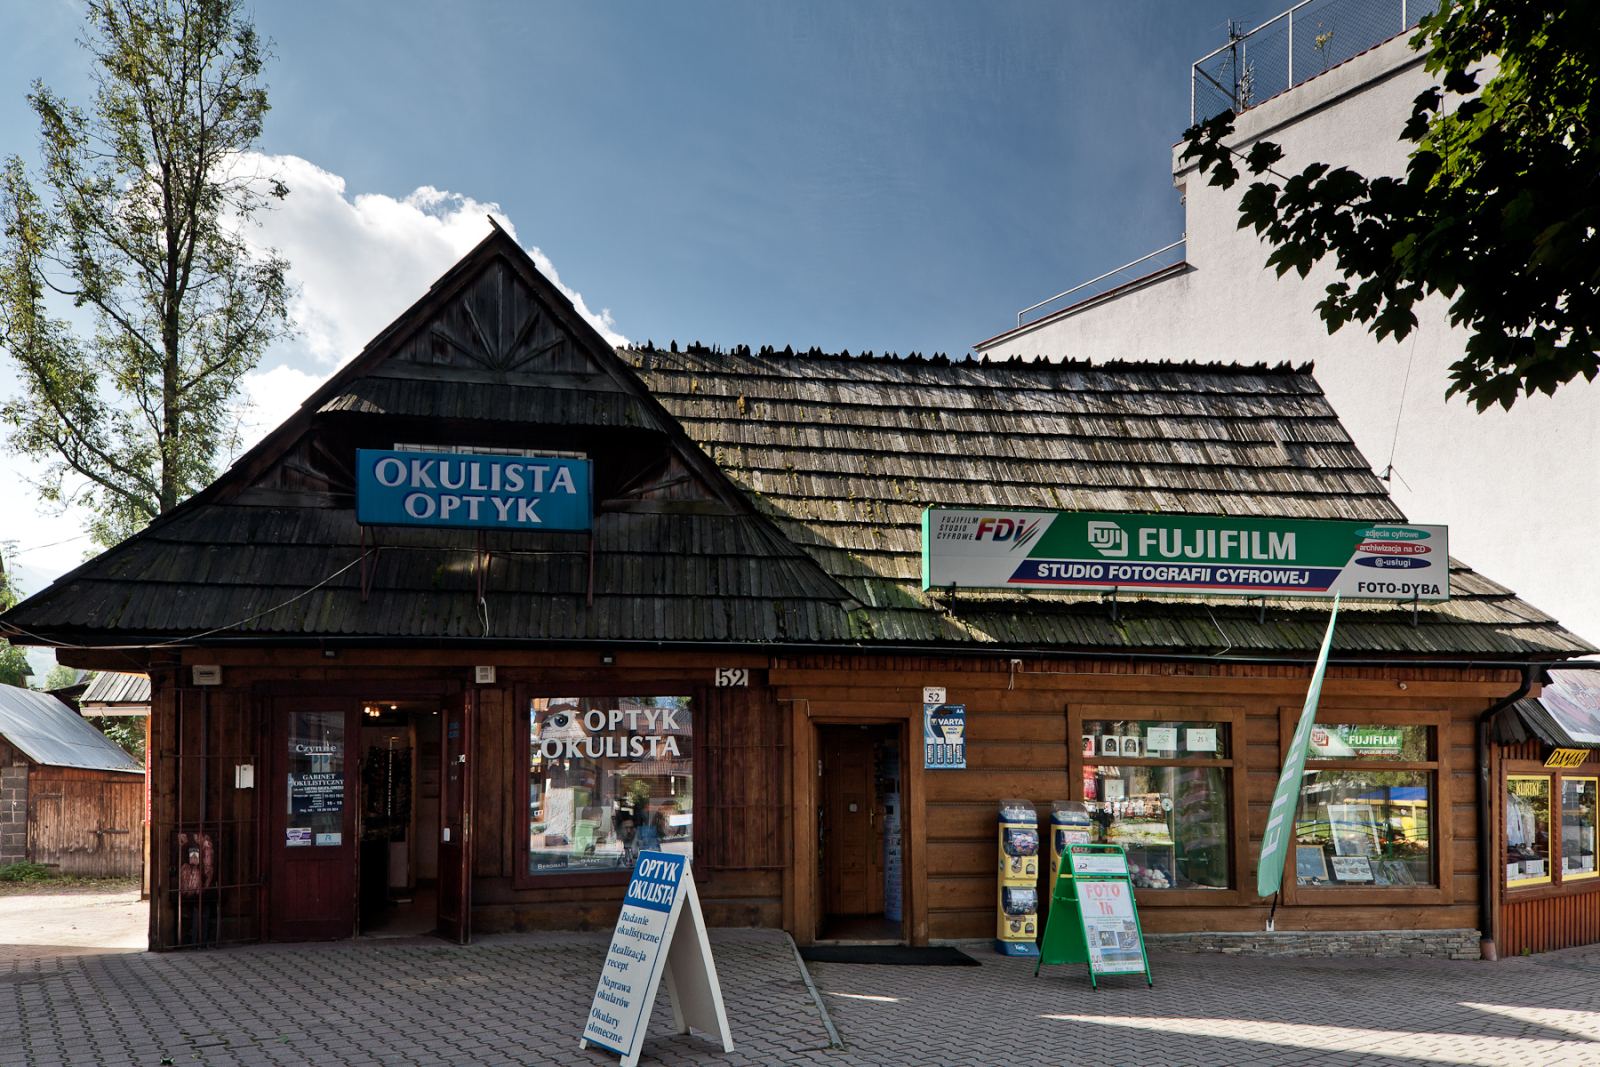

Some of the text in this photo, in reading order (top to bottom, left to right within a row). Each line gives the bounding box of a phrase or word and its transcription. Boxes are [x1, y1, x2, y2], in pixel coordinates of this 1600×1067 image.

[374, 458, 577, 494] OKULISTA
[404, 493, 542, 523] OPTYK
[942, 516, 979, 524] FUJIFILM
[939, 524, 967, 532] STUDIO
[1365, 530, 1419, 539] zdjęcia cyfrowe
[937, 532, 974, 541] CYFROWE
[1139, 528, 1297, 561] FUJIFILM
[1359, 544, 1402, 553] archiwizacja
[1414, 545, 1426, 553] CD
[1375, 558, 1411, 567] @-usługi
[1038, 563, 1309, 585] STUDIO FOTOGRAFII CYFROWEJ
[1358, 582, 1440, 595] FOTO-DYBA
[719, 667, 745, 689] 52
[928, 692, 940, 702] 52
[584, 709, 680, 732] OPTYK
[937, 718, 964, 726] VARTA
[541, 735, 681, 759] OKULISTA
[1348, 735, 1397, 745] FUJIFILM
[296, 743, 337, 753] Czynne
[294, 779, 344, 787] OKULISTYCZNY
[1515, 782, 1540, 795] KURTKI
[638, 858, 680, 882] OPTYK
[628, 879, 675, 906] OKULISTA
[1084, 883, 1120, 898] FOTO
[621, 911, 649, 926] Badanie
[617, 925, 660, 944] okulistyczne
[611, 943, 647, 962] Realizacja
[607, 959, 629, 972] recept
[601, 975, 631, 993] Naprawa
[597, 990, 630, 1008] okularów
[591, 1007, 620, 1029] Okulary
[587, 1021, 623, 1043] słoneczne
